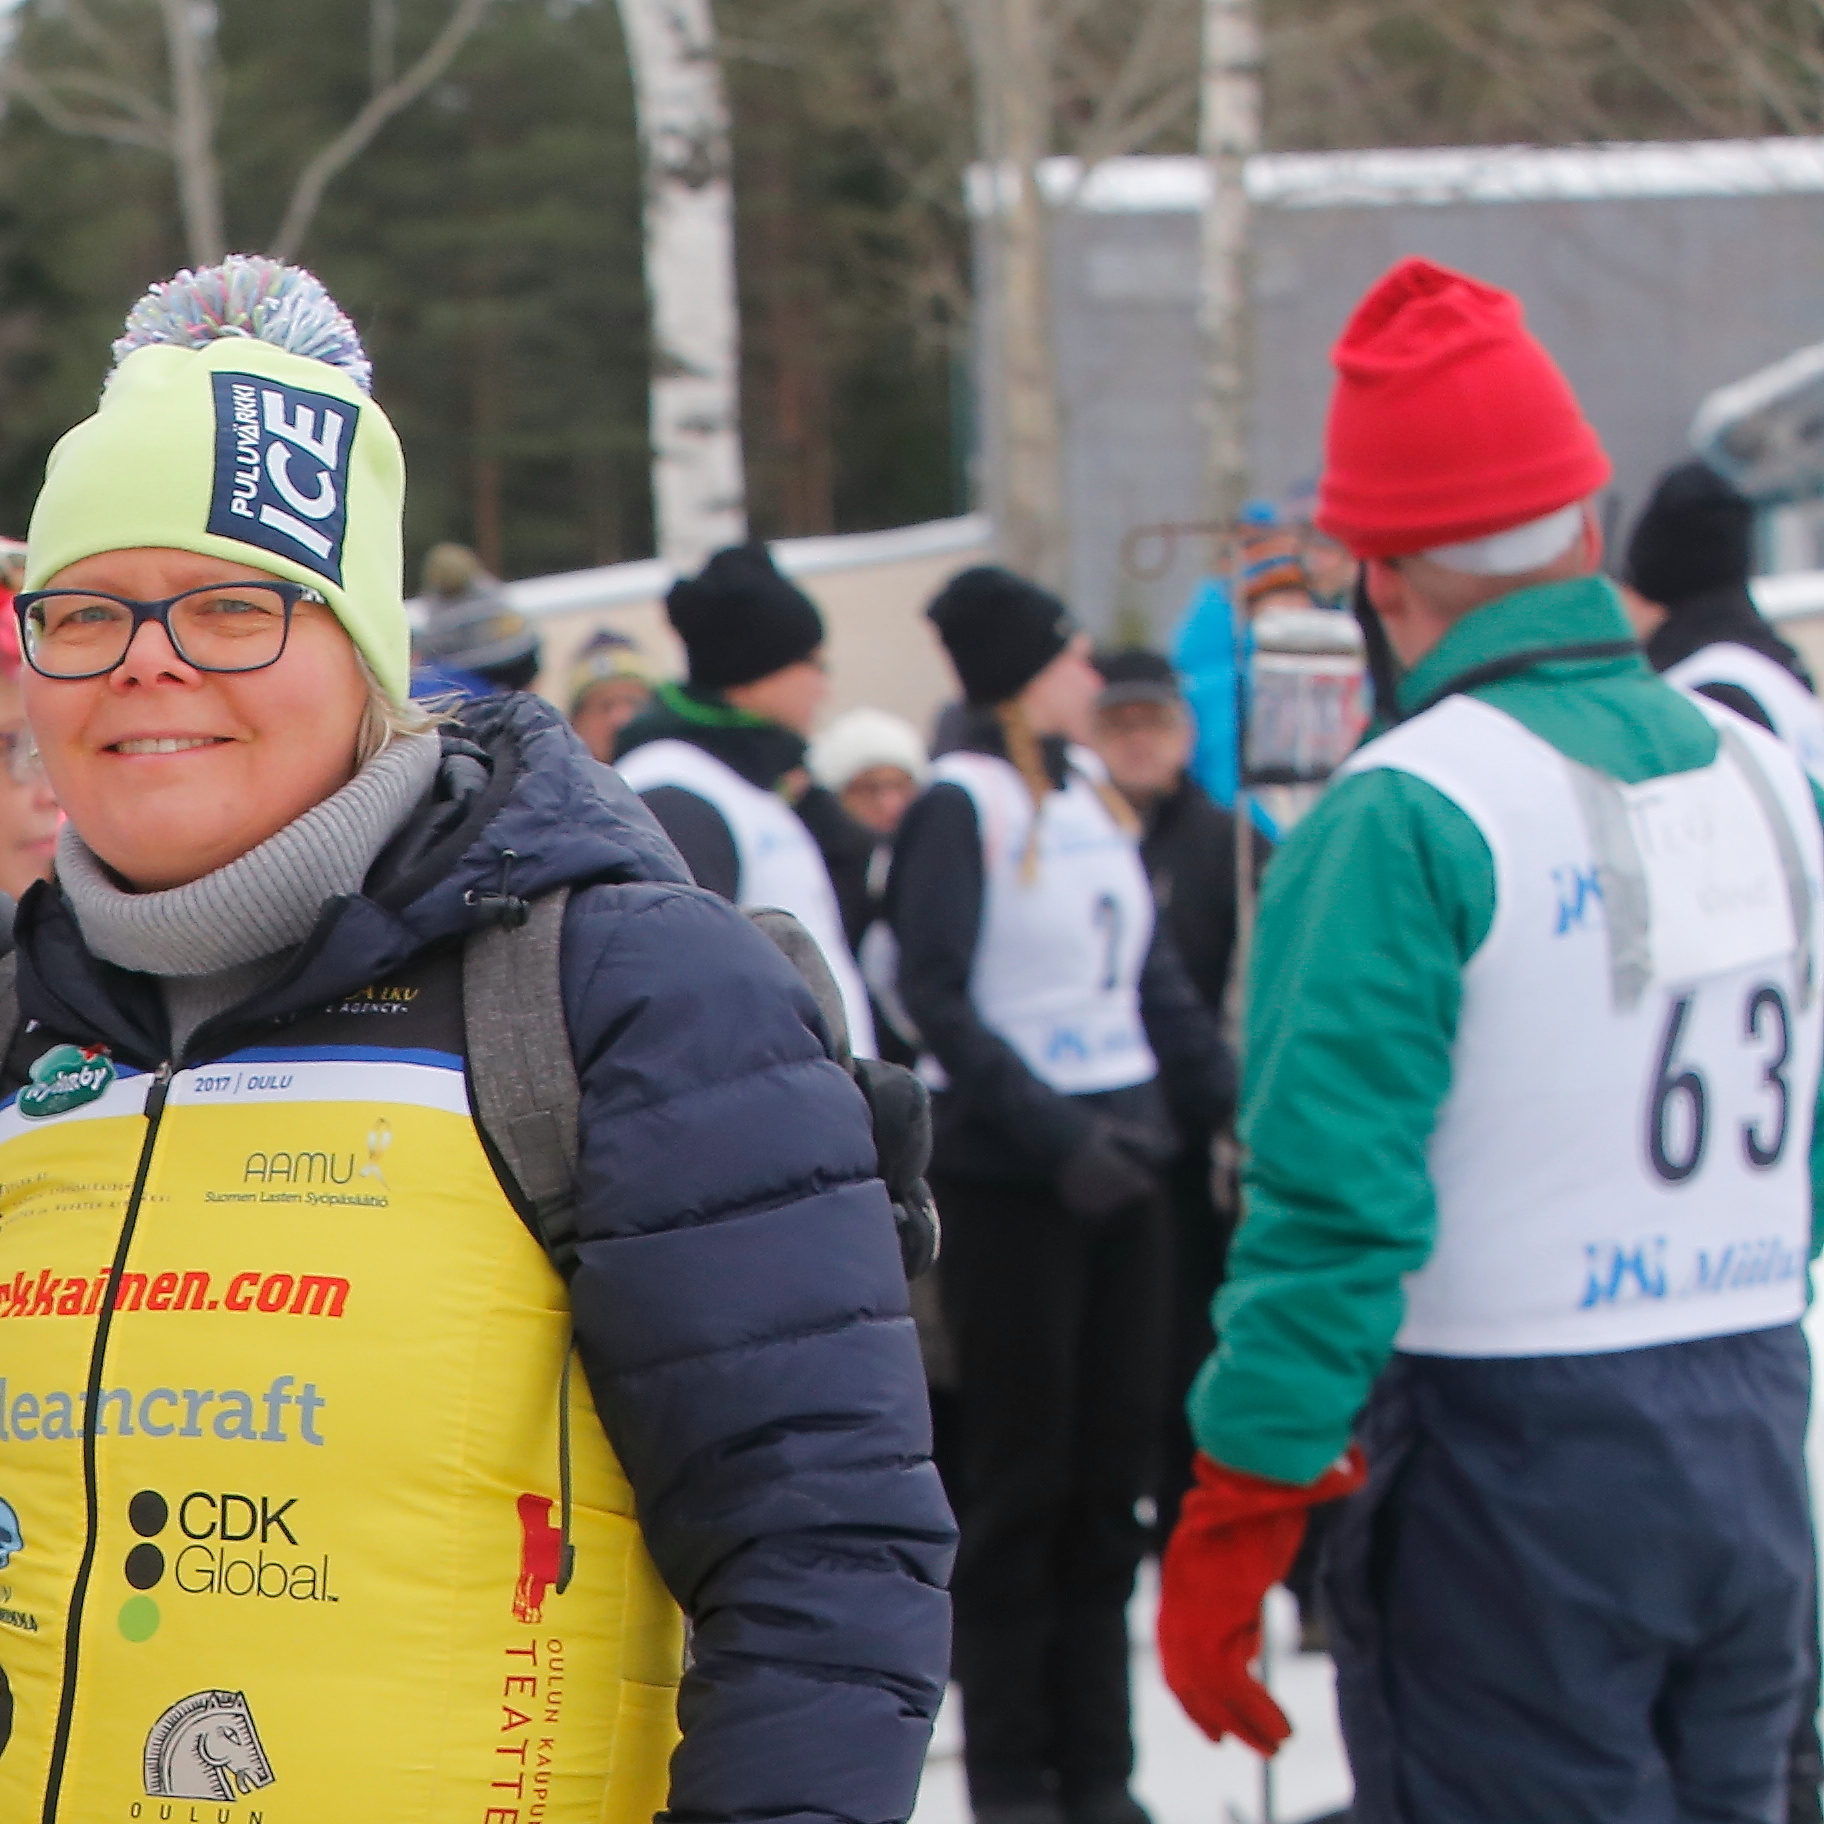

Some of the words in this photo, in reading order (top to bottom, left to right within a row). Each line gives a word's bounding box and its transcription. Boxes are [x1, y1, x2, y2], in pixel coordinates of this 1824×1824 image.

[230, 383, 261, 519] PULUVÄRKKI
[259, 389, 344, 560] ICE
[195, 1074, 230, 1092] 2017
[247, 1075, 294, 1091] OULU
[1649, 987, 1788, 1180] 63
[243, 1152, 354, 1184] AAMU
[179, 1490, 298, 1545] CDK
[544, 1638, 566, 1723] OULUN
